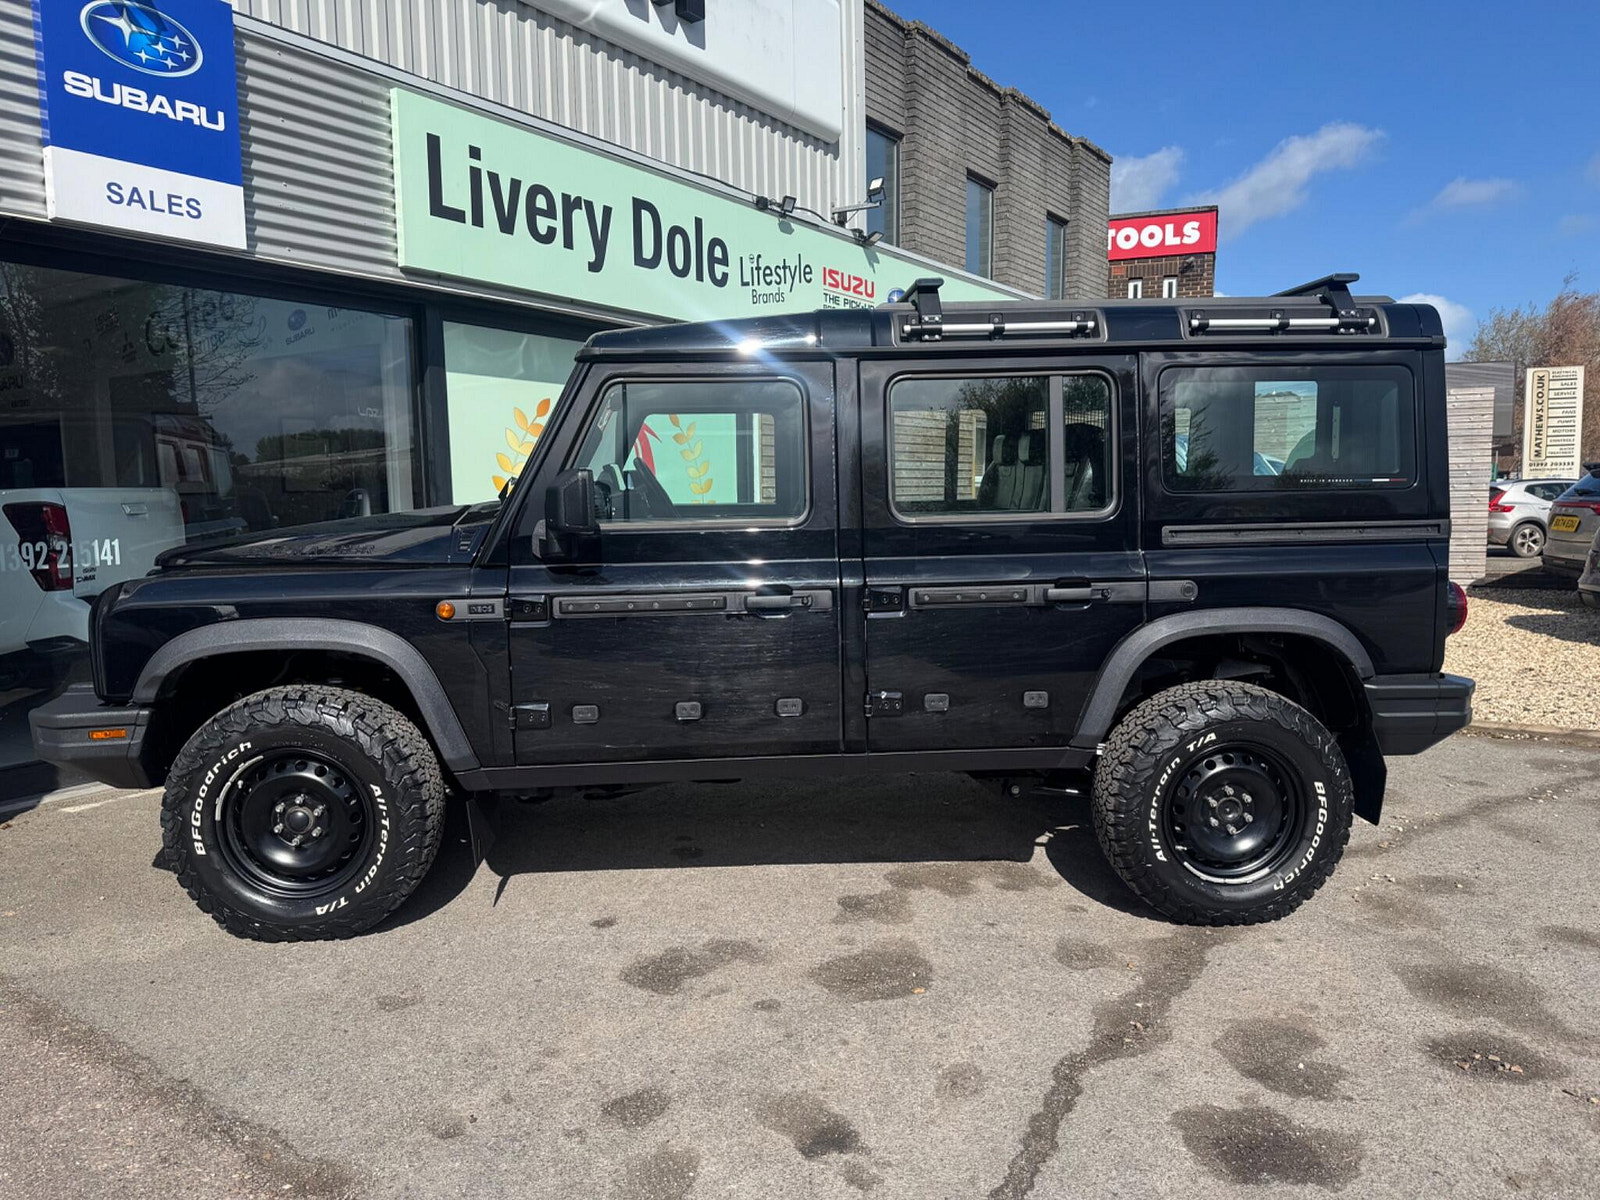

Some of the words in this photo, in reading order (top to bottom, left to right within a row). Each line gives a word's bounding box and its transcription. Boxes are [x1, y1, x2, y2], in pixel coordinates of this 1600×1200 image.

[63, 70, 226, 132] SUBARU
[106, 181, 203, 219] SALES
[426, 132, 613, 273] Livery
[631, 196, 730, 287] Dole
[740, 253, 812, 293] Lifestyle
[752, 288, 785, 304] Brands
[822, 266, 875, 298] ISUZU
[823, 292, 841, 305] THE
[1534, 374, 1546, 458] MATHEWS.CO.UK
[190, 741, 252, 857] BFGoodrich
[1149, 756, 1181, 863] All-Terrain
[1186, 732, 1217, 752] T/A
[354, 782, 390, 895] All-Terrain
[1273, 781, 1328, 892] BFGoodrich
[315, 895, 349, 917] T/A
